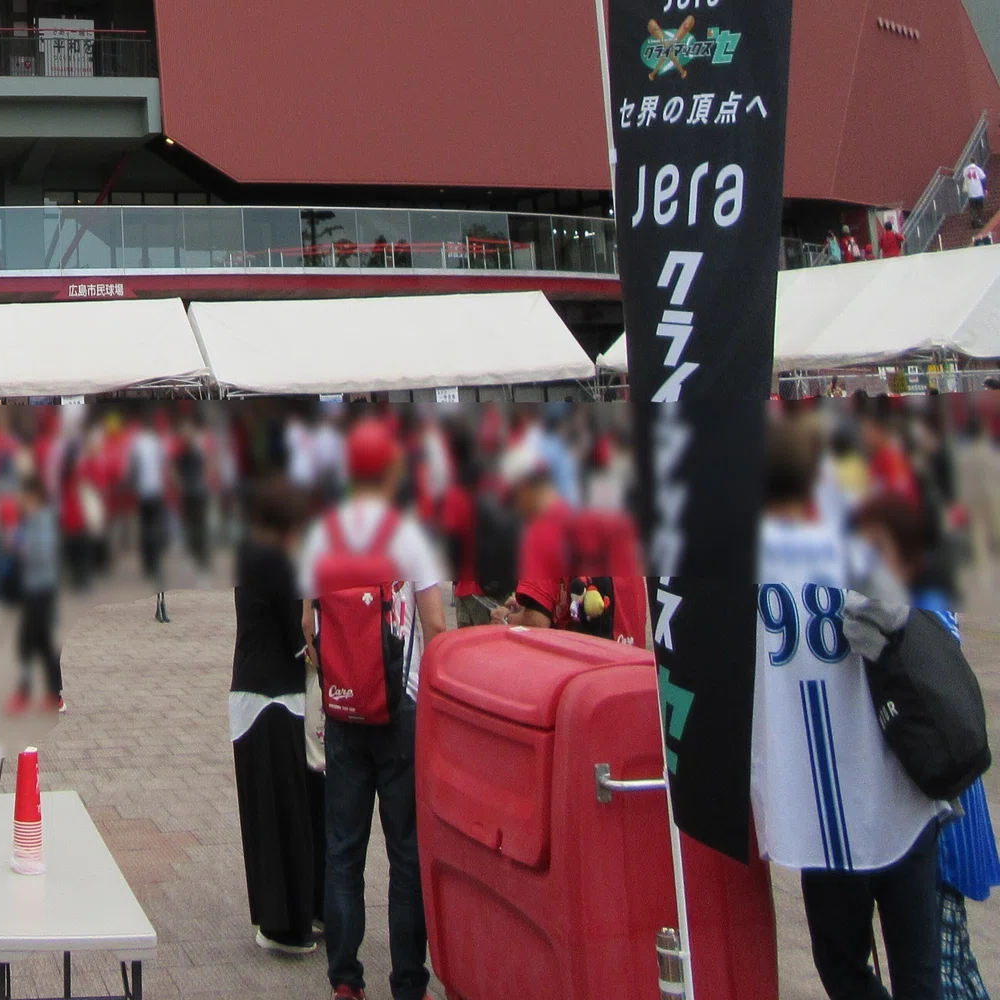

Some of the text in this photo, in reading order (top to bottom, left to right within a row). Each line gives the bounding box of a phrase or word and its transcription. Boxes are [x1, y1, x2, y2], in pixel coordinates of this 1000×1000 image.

[619, 91, 769, 129] セ界の頂点へ
[68, 283, 124, 297] 広島市民球場
[757, 582, 851, 667] 98
[328, 684, 354, 701] Carp
